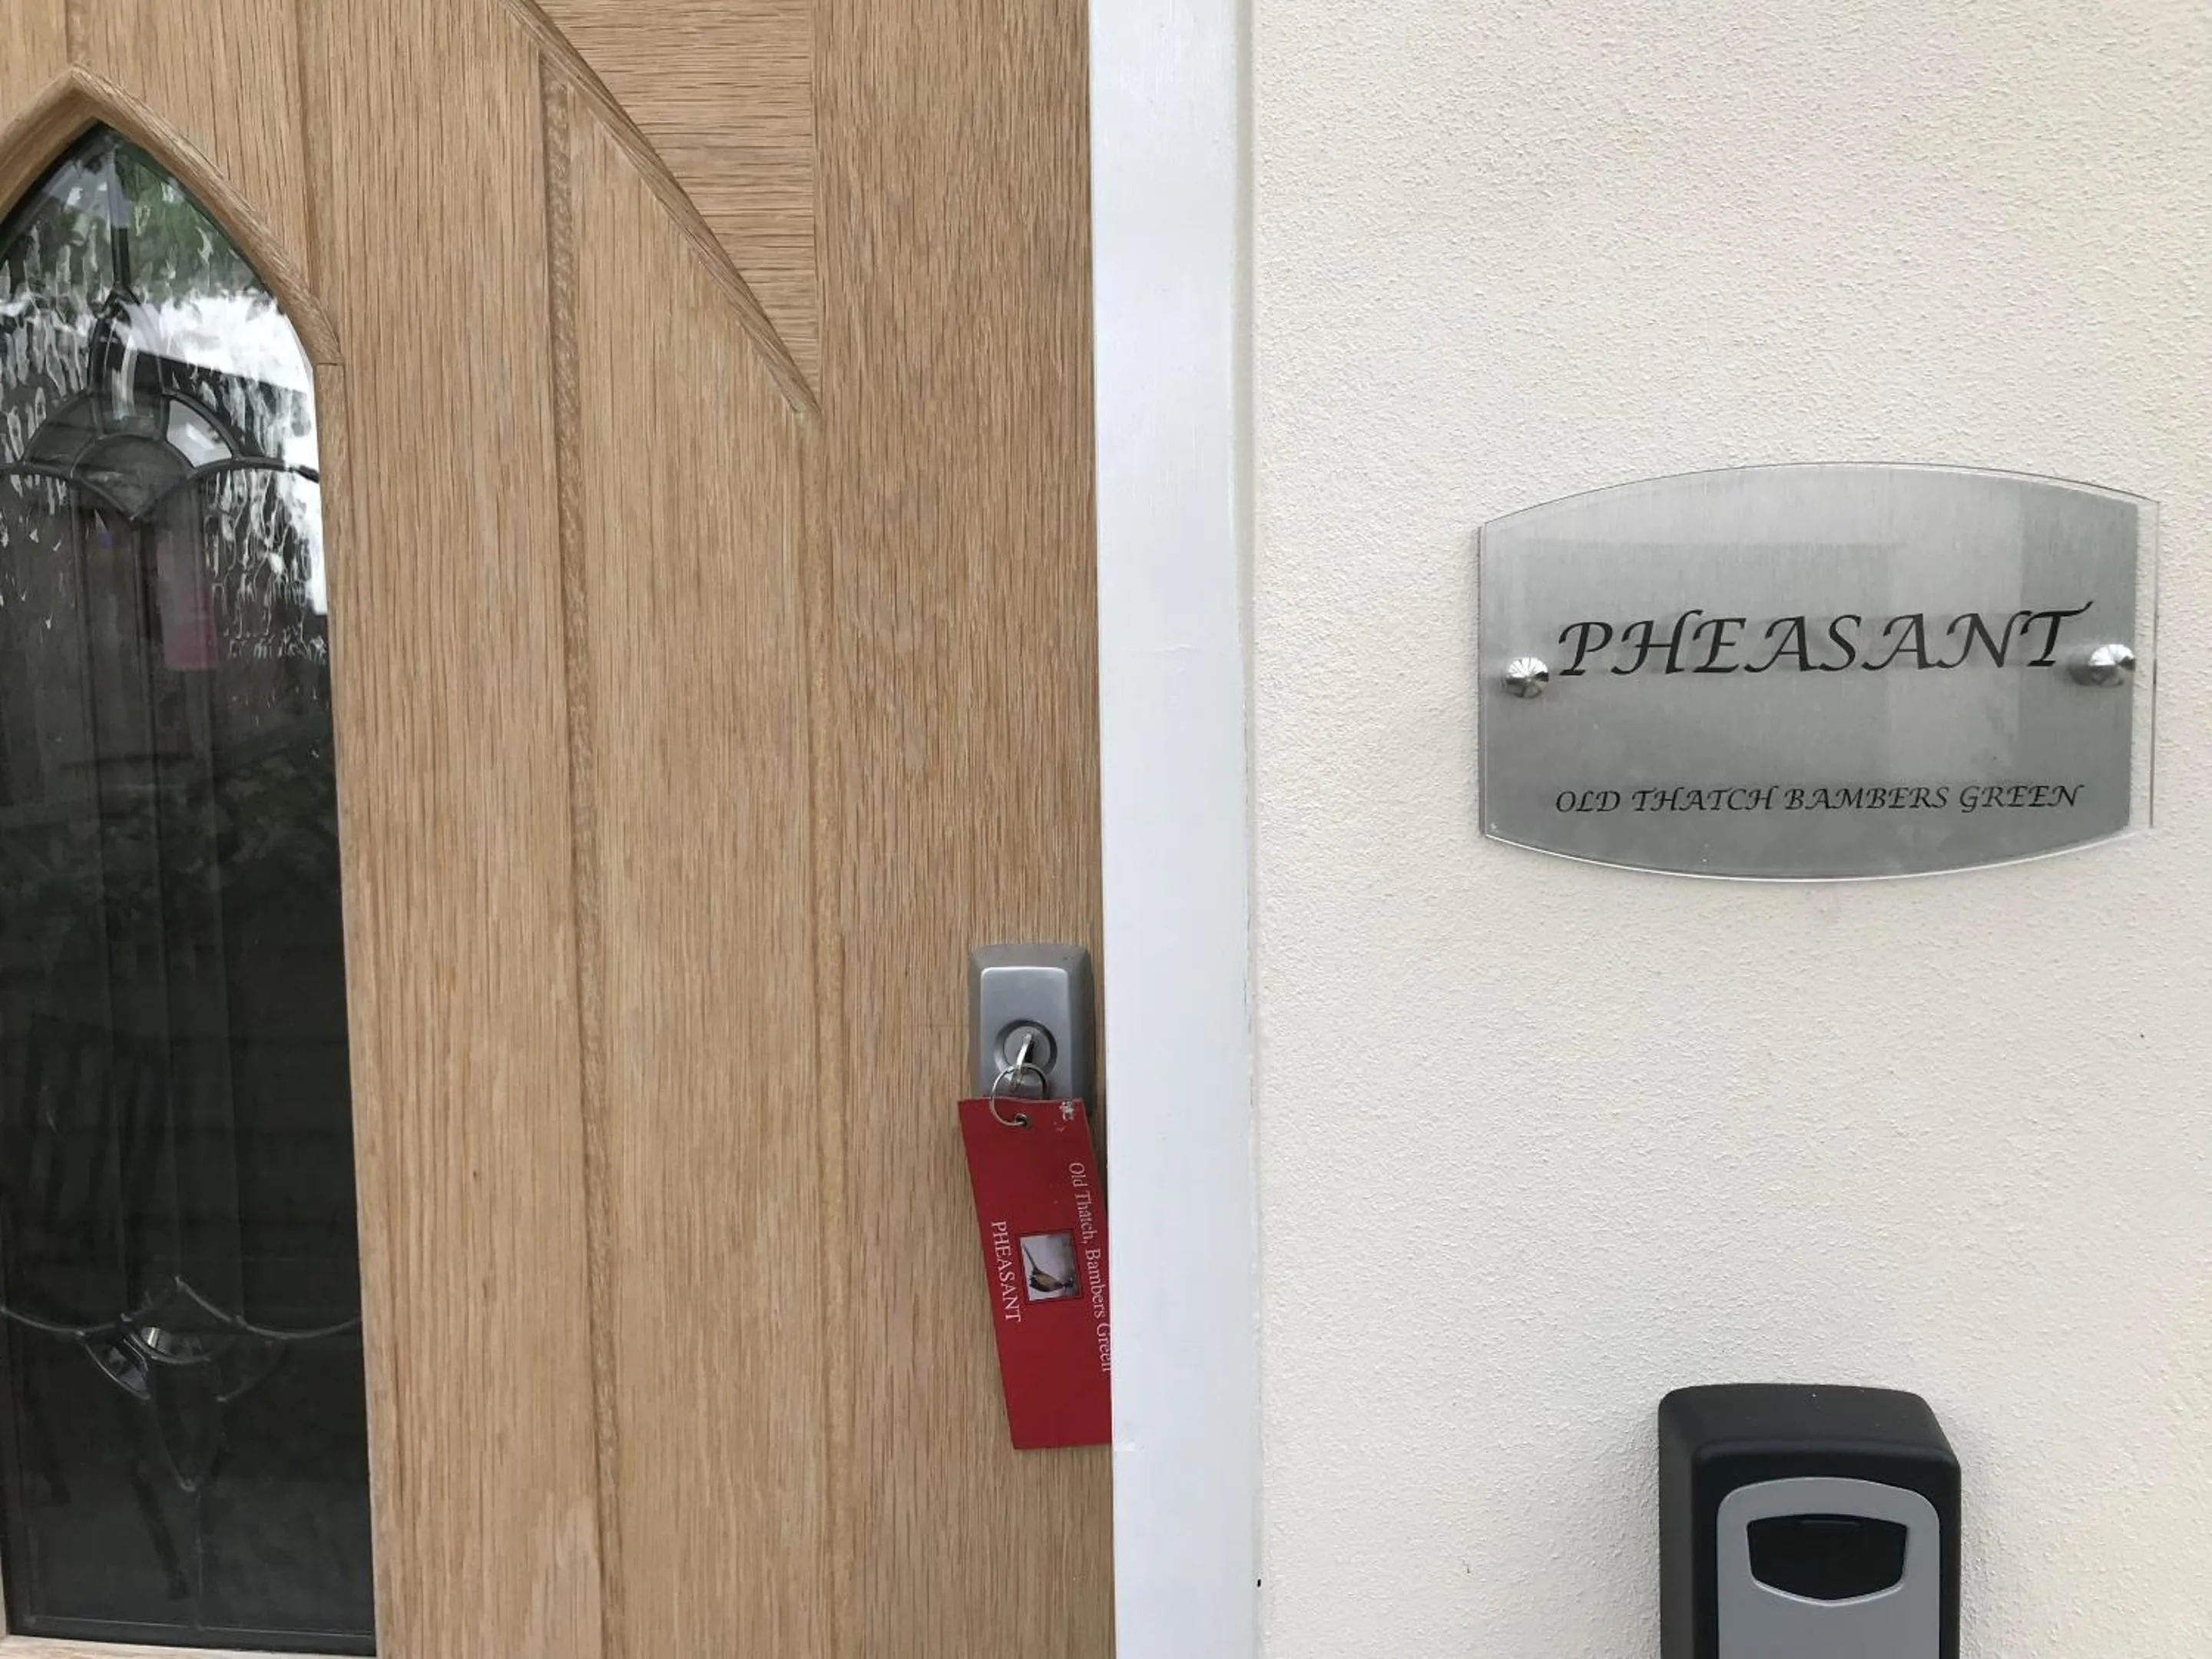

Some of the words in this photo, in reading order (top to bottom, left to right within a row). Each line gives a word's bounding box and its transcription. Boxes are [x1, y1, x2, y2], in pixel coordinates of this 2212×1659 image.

[1558, 601, 2095, 677] PHEASANT
[1555, 789, 1621, 814] OLD
[1631, 786, 1779, 813] THATCH
[1783, 786, 1949, 811] BAMBERS
[1960, 784, 2084, 813] GREEN
[1068, 1162, 1088, 1187] Old
[1075, 1190, 1098, 1244] Thatch,
[991, 1220, 1022, 1322] PHEASANT
[1085, 1247, 1106, 1320] Bambers
[1096, 1322, 1111, 1373] Green
